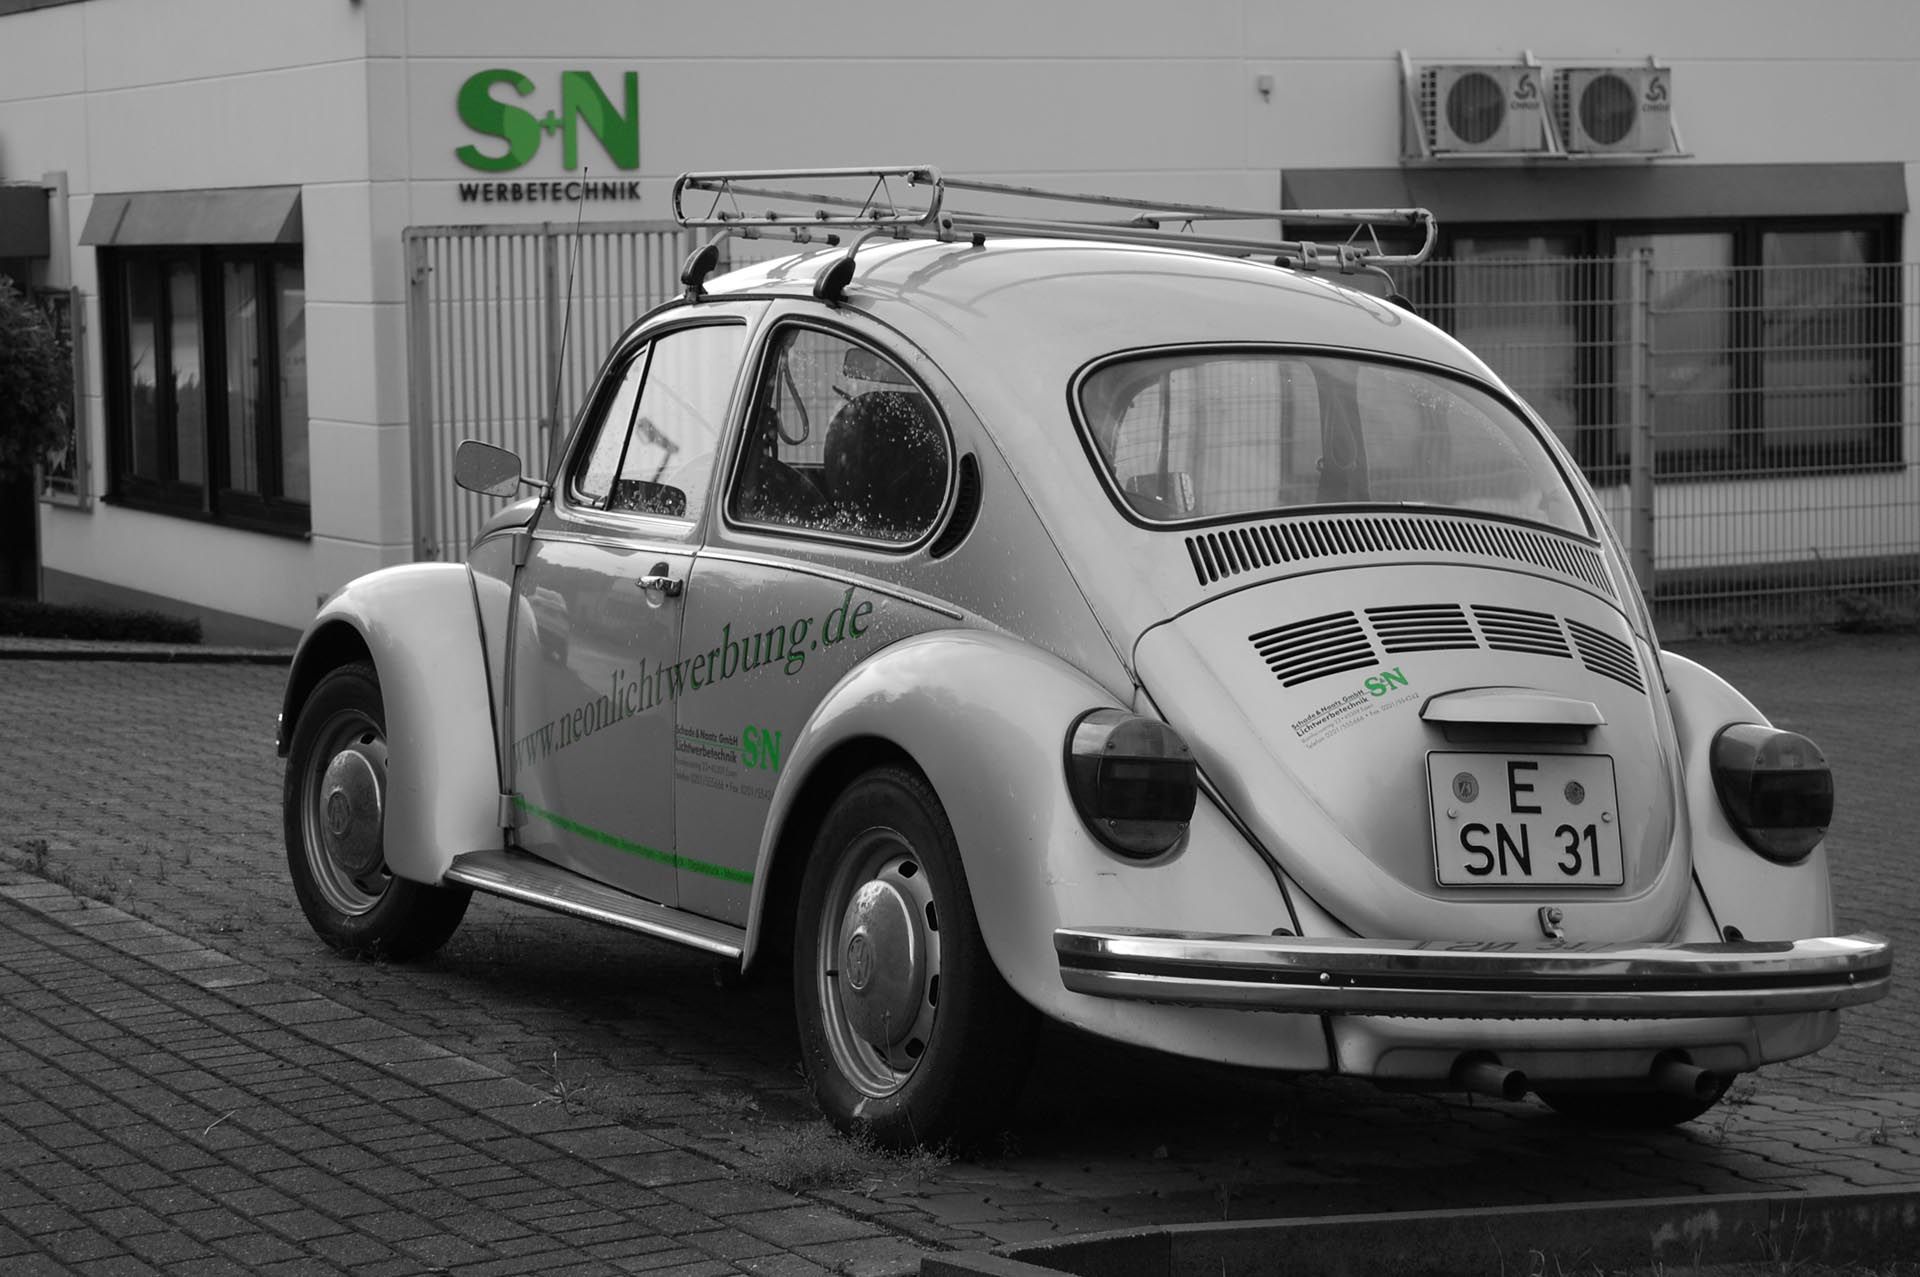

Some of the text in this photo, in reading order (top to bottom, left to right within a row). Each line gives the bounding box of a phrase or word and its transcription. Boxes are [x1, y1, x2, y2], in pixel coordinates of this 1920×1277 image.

[455, 68, 640, 174] S+N
[458, 181, 641, 203] WERBETECHNIK
[512, 586, 873, 773] www.neonlichtwerbung.de
[1342, 690, 1365, 703] GmbH
[1296, 697, 1369, 737] Lichtwerbetechnik
[1507, 761, 1542, 814] E
[1460, 823, 1600, 876] SN 31
